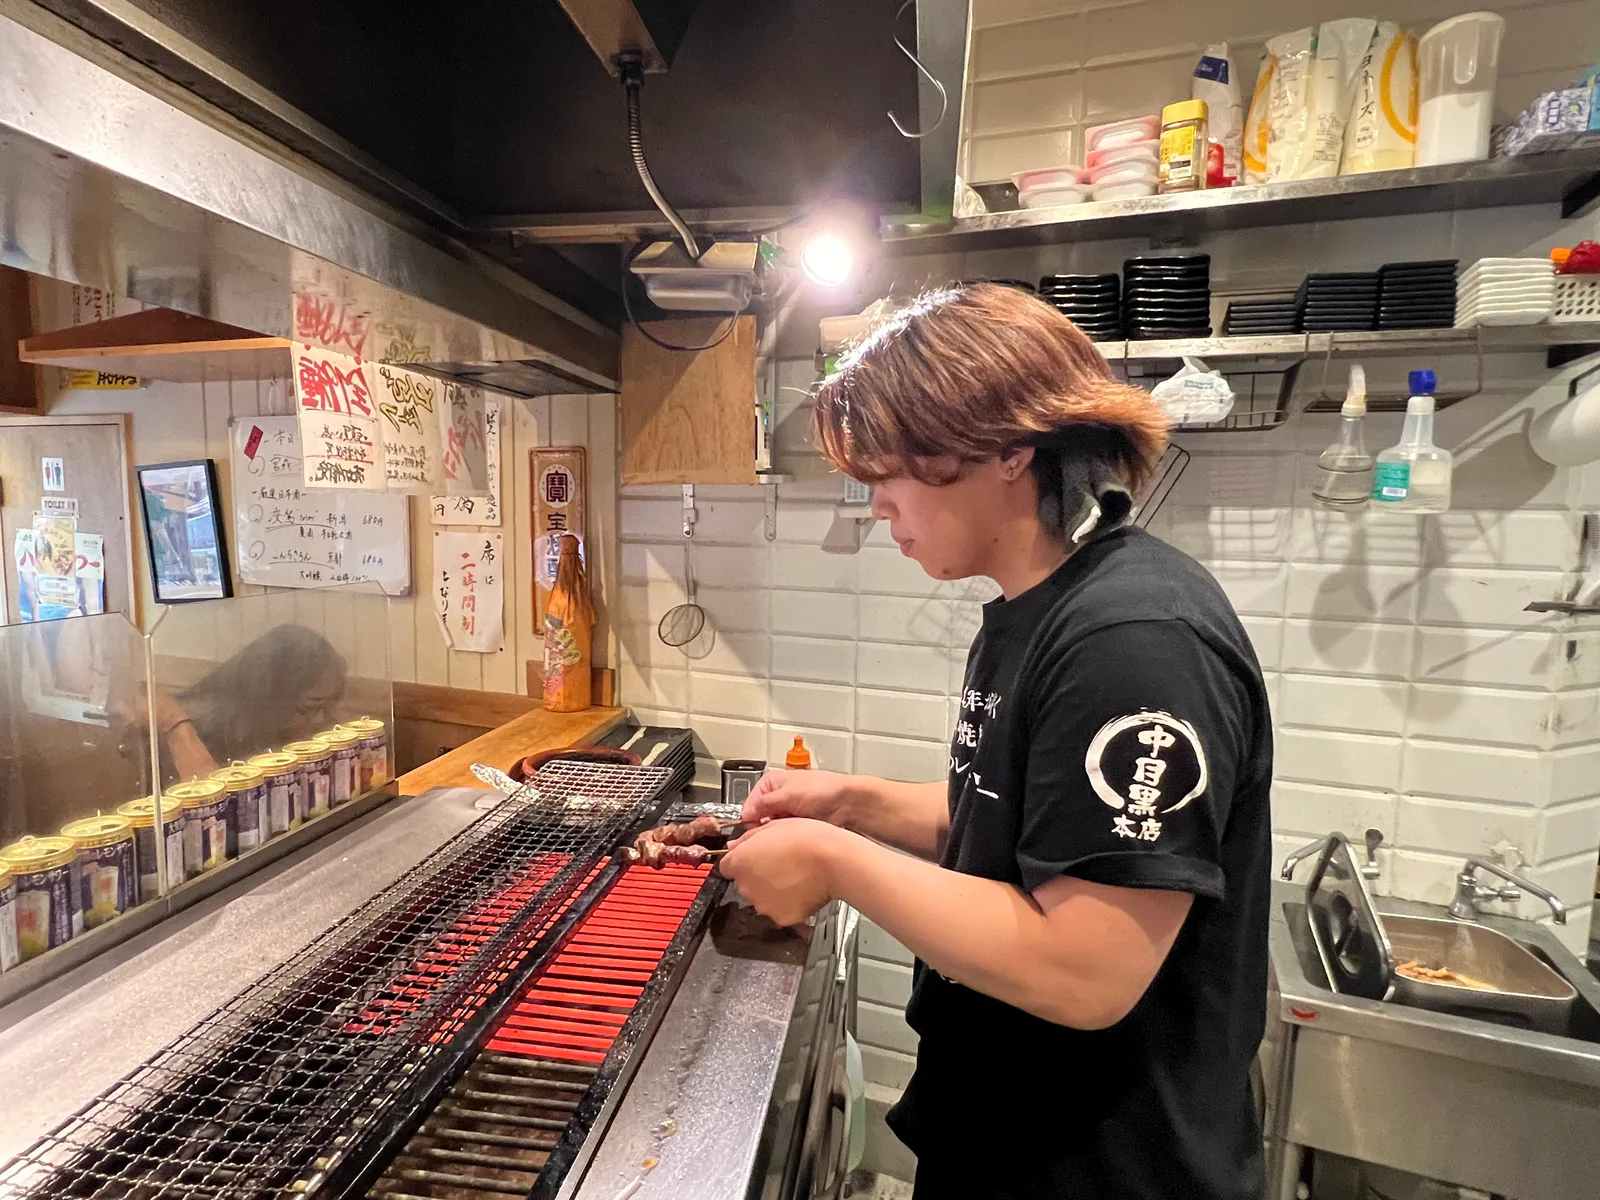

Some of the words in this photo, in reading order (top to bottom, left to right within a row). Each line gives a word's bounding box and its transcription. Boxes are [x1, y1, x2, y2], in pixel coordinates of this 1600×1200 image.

[44, 500, 65, 509] TOILET
[460, 551, 478, 636] 二時間制
[1128, 724, 1175, 817] 中目黒
[1111, 814, 1162, 842] 本店
